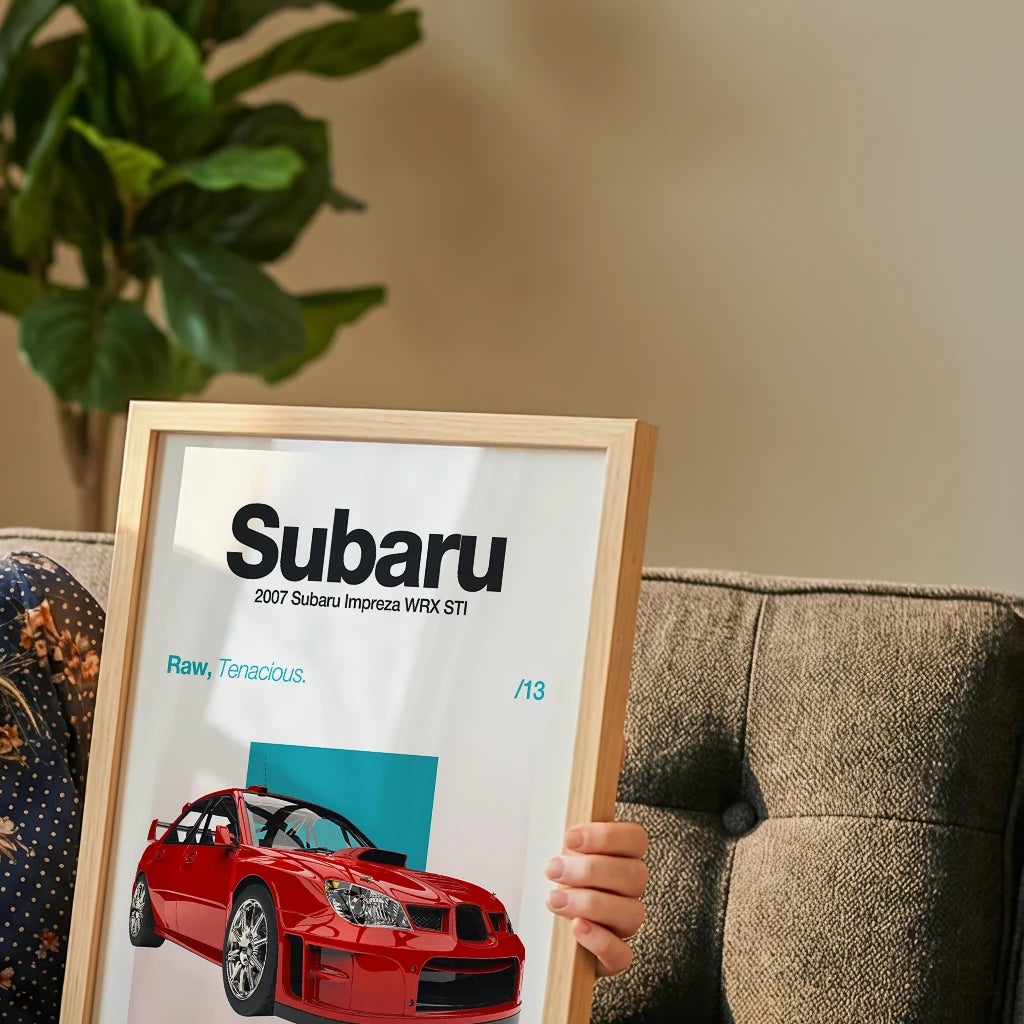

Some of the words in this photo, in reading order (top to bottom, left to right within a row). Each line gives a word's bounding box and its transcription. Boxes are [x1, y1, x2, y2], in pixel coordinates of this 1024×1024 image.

[226, 502, 508, 593] Subaru
[254, 589, 288, 604] 2007
[291, 590, 340, 608] Subaru
[344, 594, 401, 613] Impreza
[405, 597, 440, 614] WRX
[443, 600, 468, 615] STI
[167, 654, 212, 680] Raw,
[219, 658, 306, 683] Tenacious.
[514, 679, 546, 701] /13
